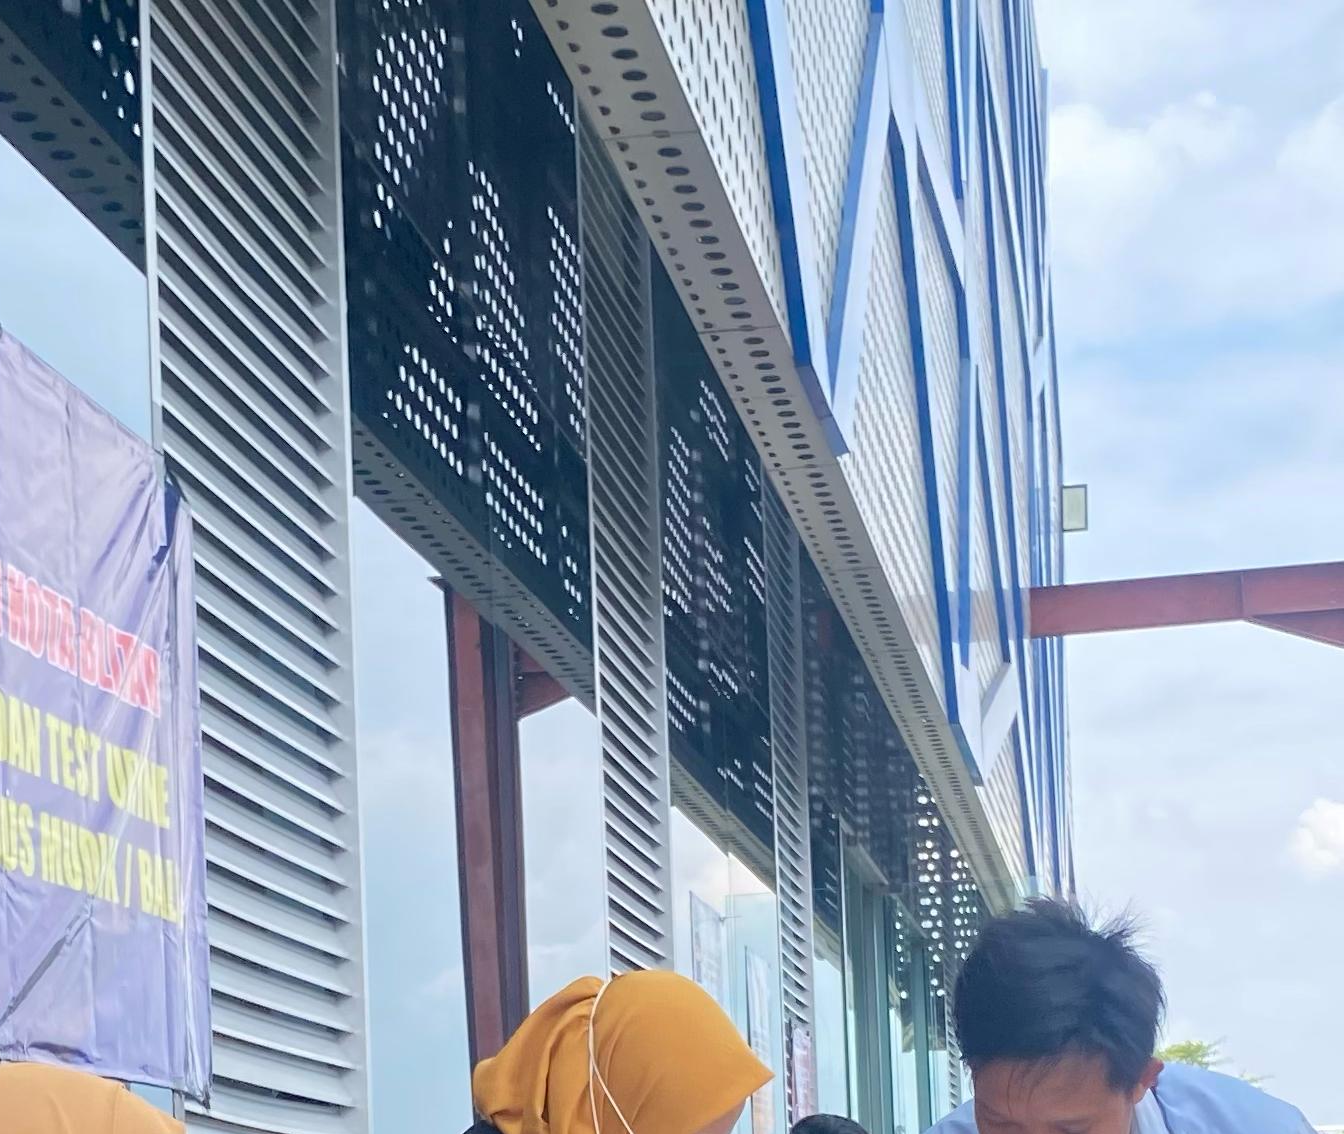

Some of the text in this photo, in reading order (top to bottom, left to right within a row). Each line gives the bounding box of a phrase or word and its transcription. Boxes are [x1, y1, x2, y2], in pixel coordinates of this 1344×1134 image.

[7, 563, 78, 677] KOTA
[79, 606, 161, 720] BLITAR
[45, 712, 102, 802] TEST
